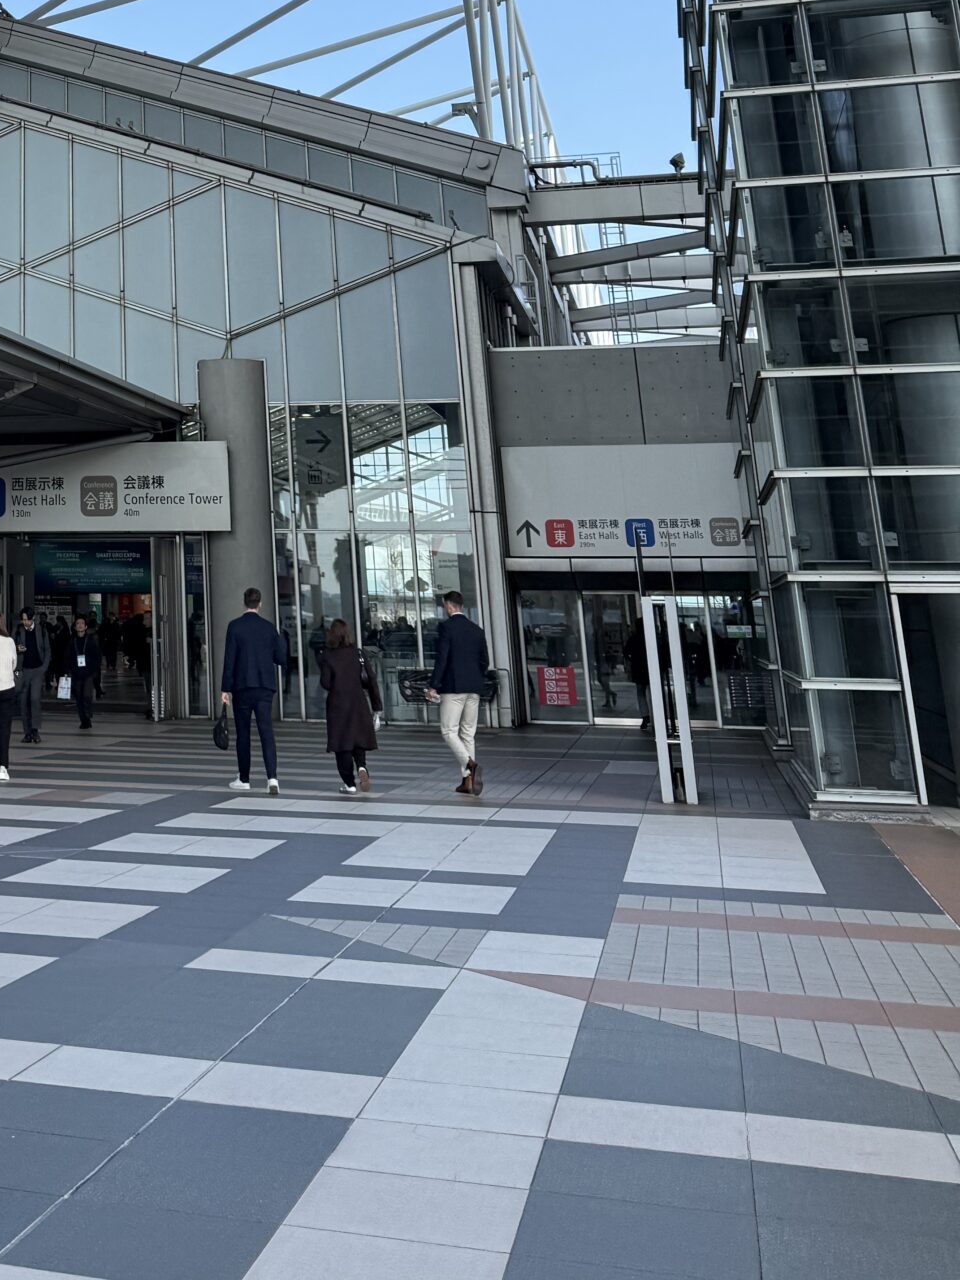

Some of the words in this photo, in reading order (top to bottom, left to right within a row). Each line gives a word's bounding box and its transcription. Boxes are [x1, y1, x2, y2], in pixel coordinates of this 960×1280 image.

[11, 477, 65, 491] 西展示棟
[83, 480, 115, 489] Conference
[123, 475, 165, 489] 会議棟
[11, 494, 38, 507] West
[41, 494, 67, 506] Halls
[83, 492, 115, 510] 会議
[123, 492, 186, 505] Conference
[189, 492, 224, 505] Tower
[11, 509, 31, 518] 130m
[123, 508, 140, 517] 40m
[577, 519, 620, 530] 東展示棟
[657, 518, 701, 529] 西展示棟
[553, 530, 568, 545] 東
[578, 532, 598, 541] East
[599, 531, 620, 540] Halls
[659, 531, 681, 540] West
[683, 531, 705, 540] Halls
[712, 528, 738, 543] 会議
